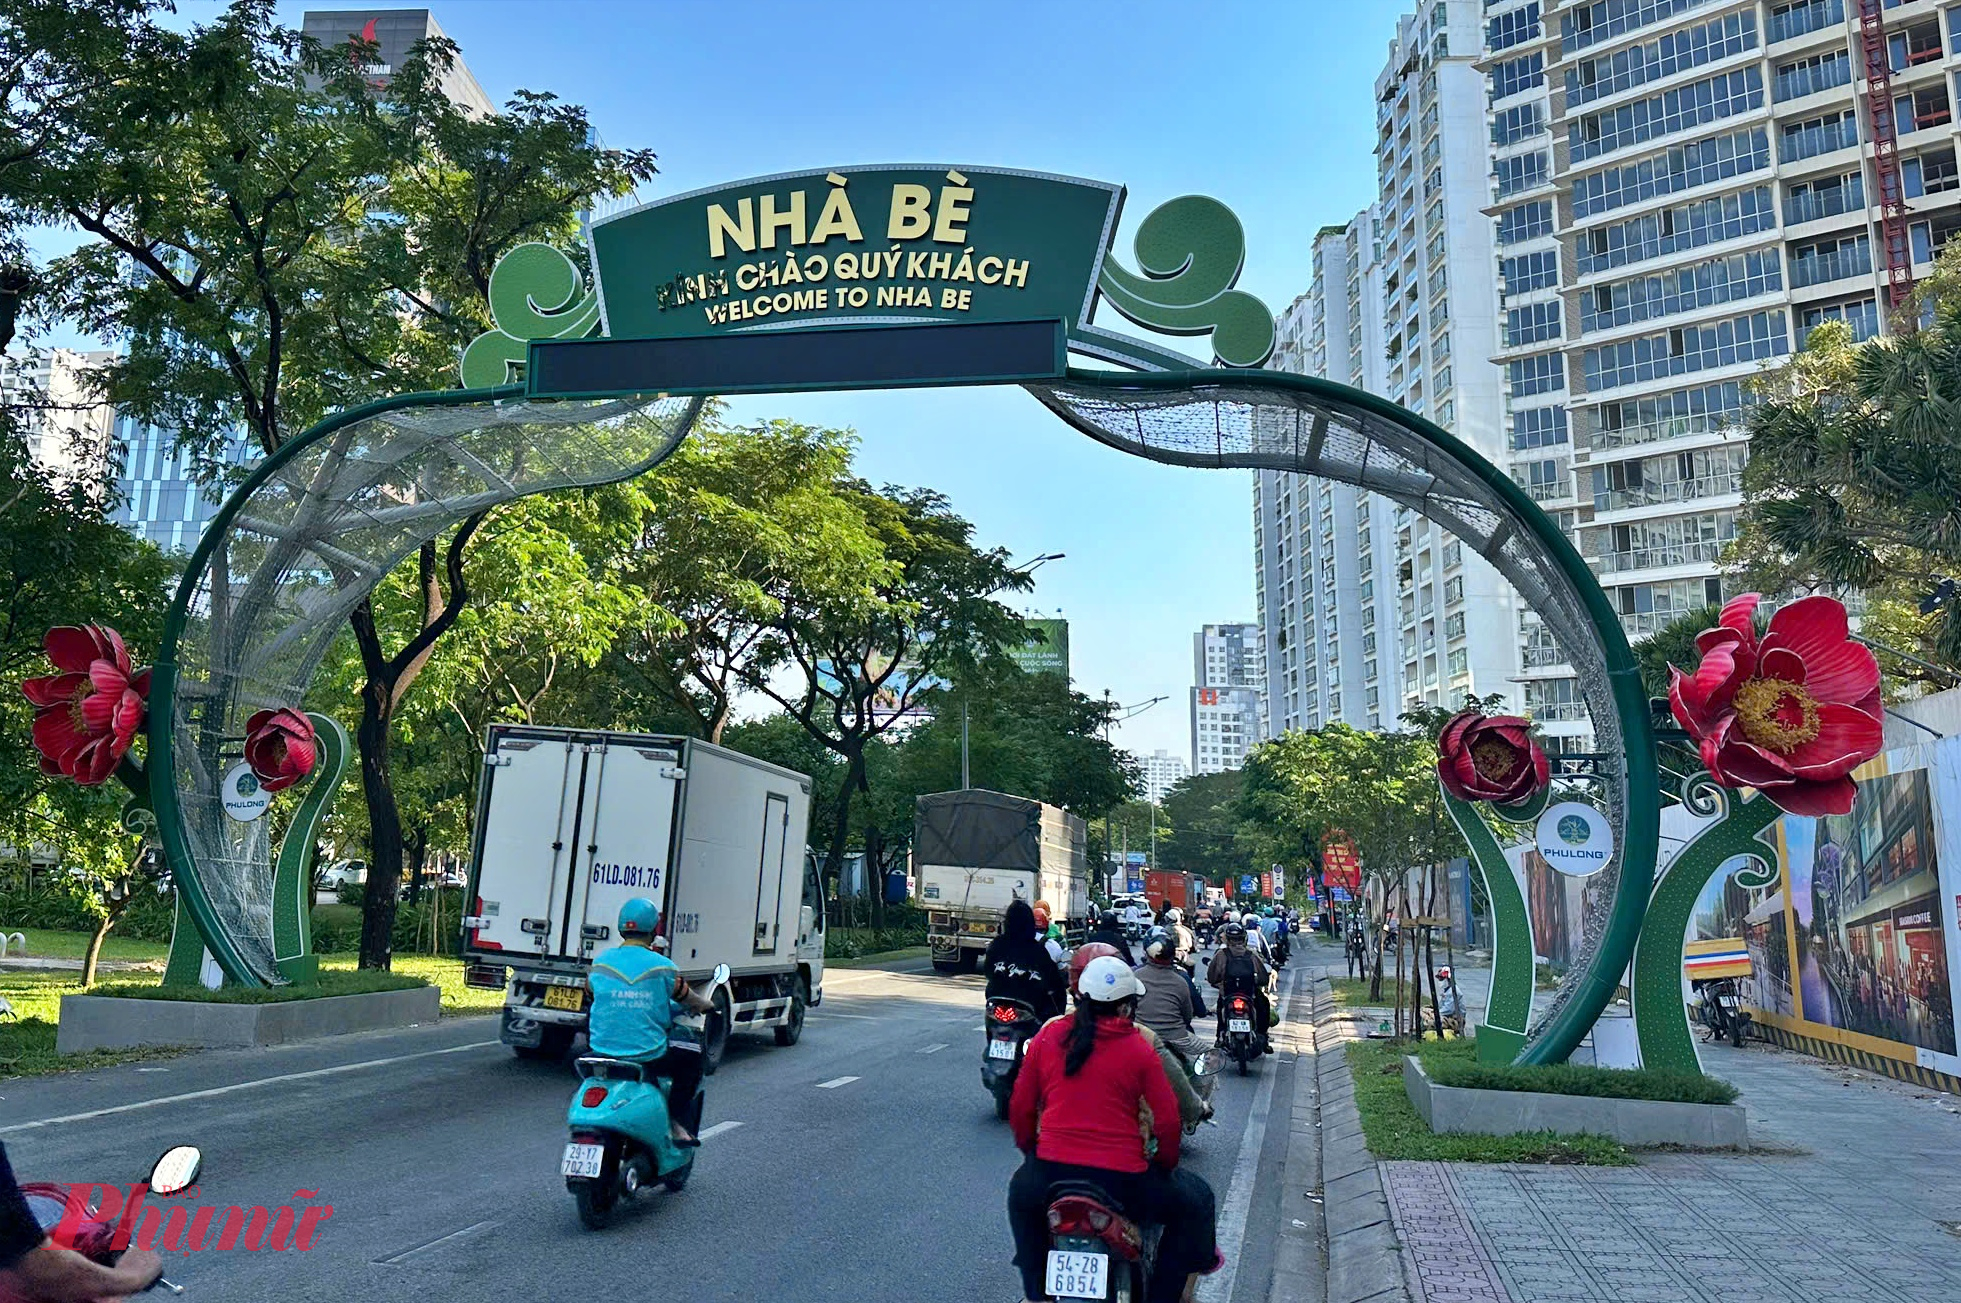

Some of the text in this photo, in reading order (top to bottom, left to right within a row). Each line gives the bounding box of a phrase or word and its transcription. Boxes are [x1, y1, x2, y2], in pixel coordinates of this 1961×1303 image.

[707, 169, 975, 258] NHÀ BÈ
[735, 250, 829, 291] CHÀO
[833, 243, 902, 280] QUÝ
[906, 246, 1030, 288] KHÁCH
[704, 286, 972, 325] WELCOME TO NHA BE
[225, 800, 265, 809] PHULONG
[1544, 848, 1604, 859] PHULONG
[1056, 1255, 1099, 1274] 54-Z8
[1055, 1274, 1097, 1295] 6854
